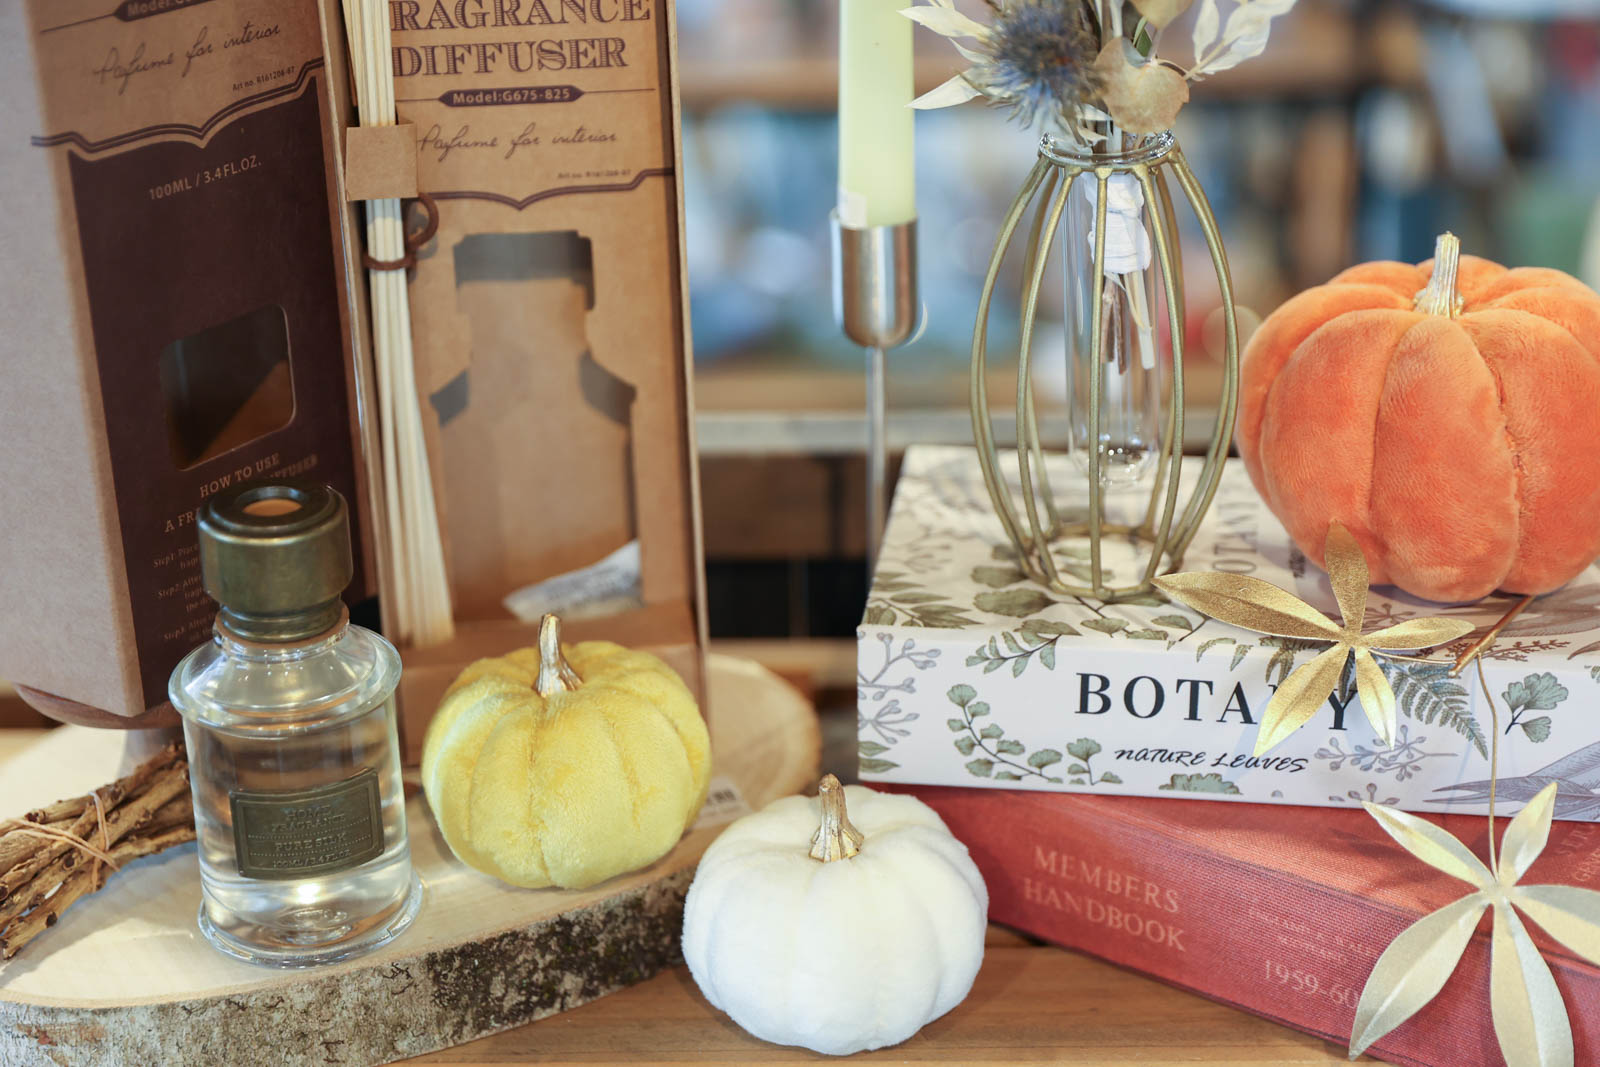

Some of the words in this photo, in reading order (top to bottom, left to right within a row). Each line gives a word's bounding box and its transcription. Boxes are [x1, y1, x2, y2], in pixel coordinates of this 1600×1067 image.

[224, 21, 280, 49] interior
[389, 0, 650, 31] RAGRANCE
[392, 37, 629, 77] DIFFUSER
[504, 121, 540, 160] for
[552, 125, 617, 144] interior
[149, 177, 193, 200] 100ML
[200, 475, 231, 498] HOW
[235, 465, 253, 481] TO
[256, 452, 280, 473] USE
[164, 519, 176, 534] A
[1074, 672, 1358, 731] BOTAY
[1034, 845, 1179, 914] MEMBERS
[1024, 877, 1186, 953] HANDBOOK
[1265, 959, 1359, 1009] 1959-60
